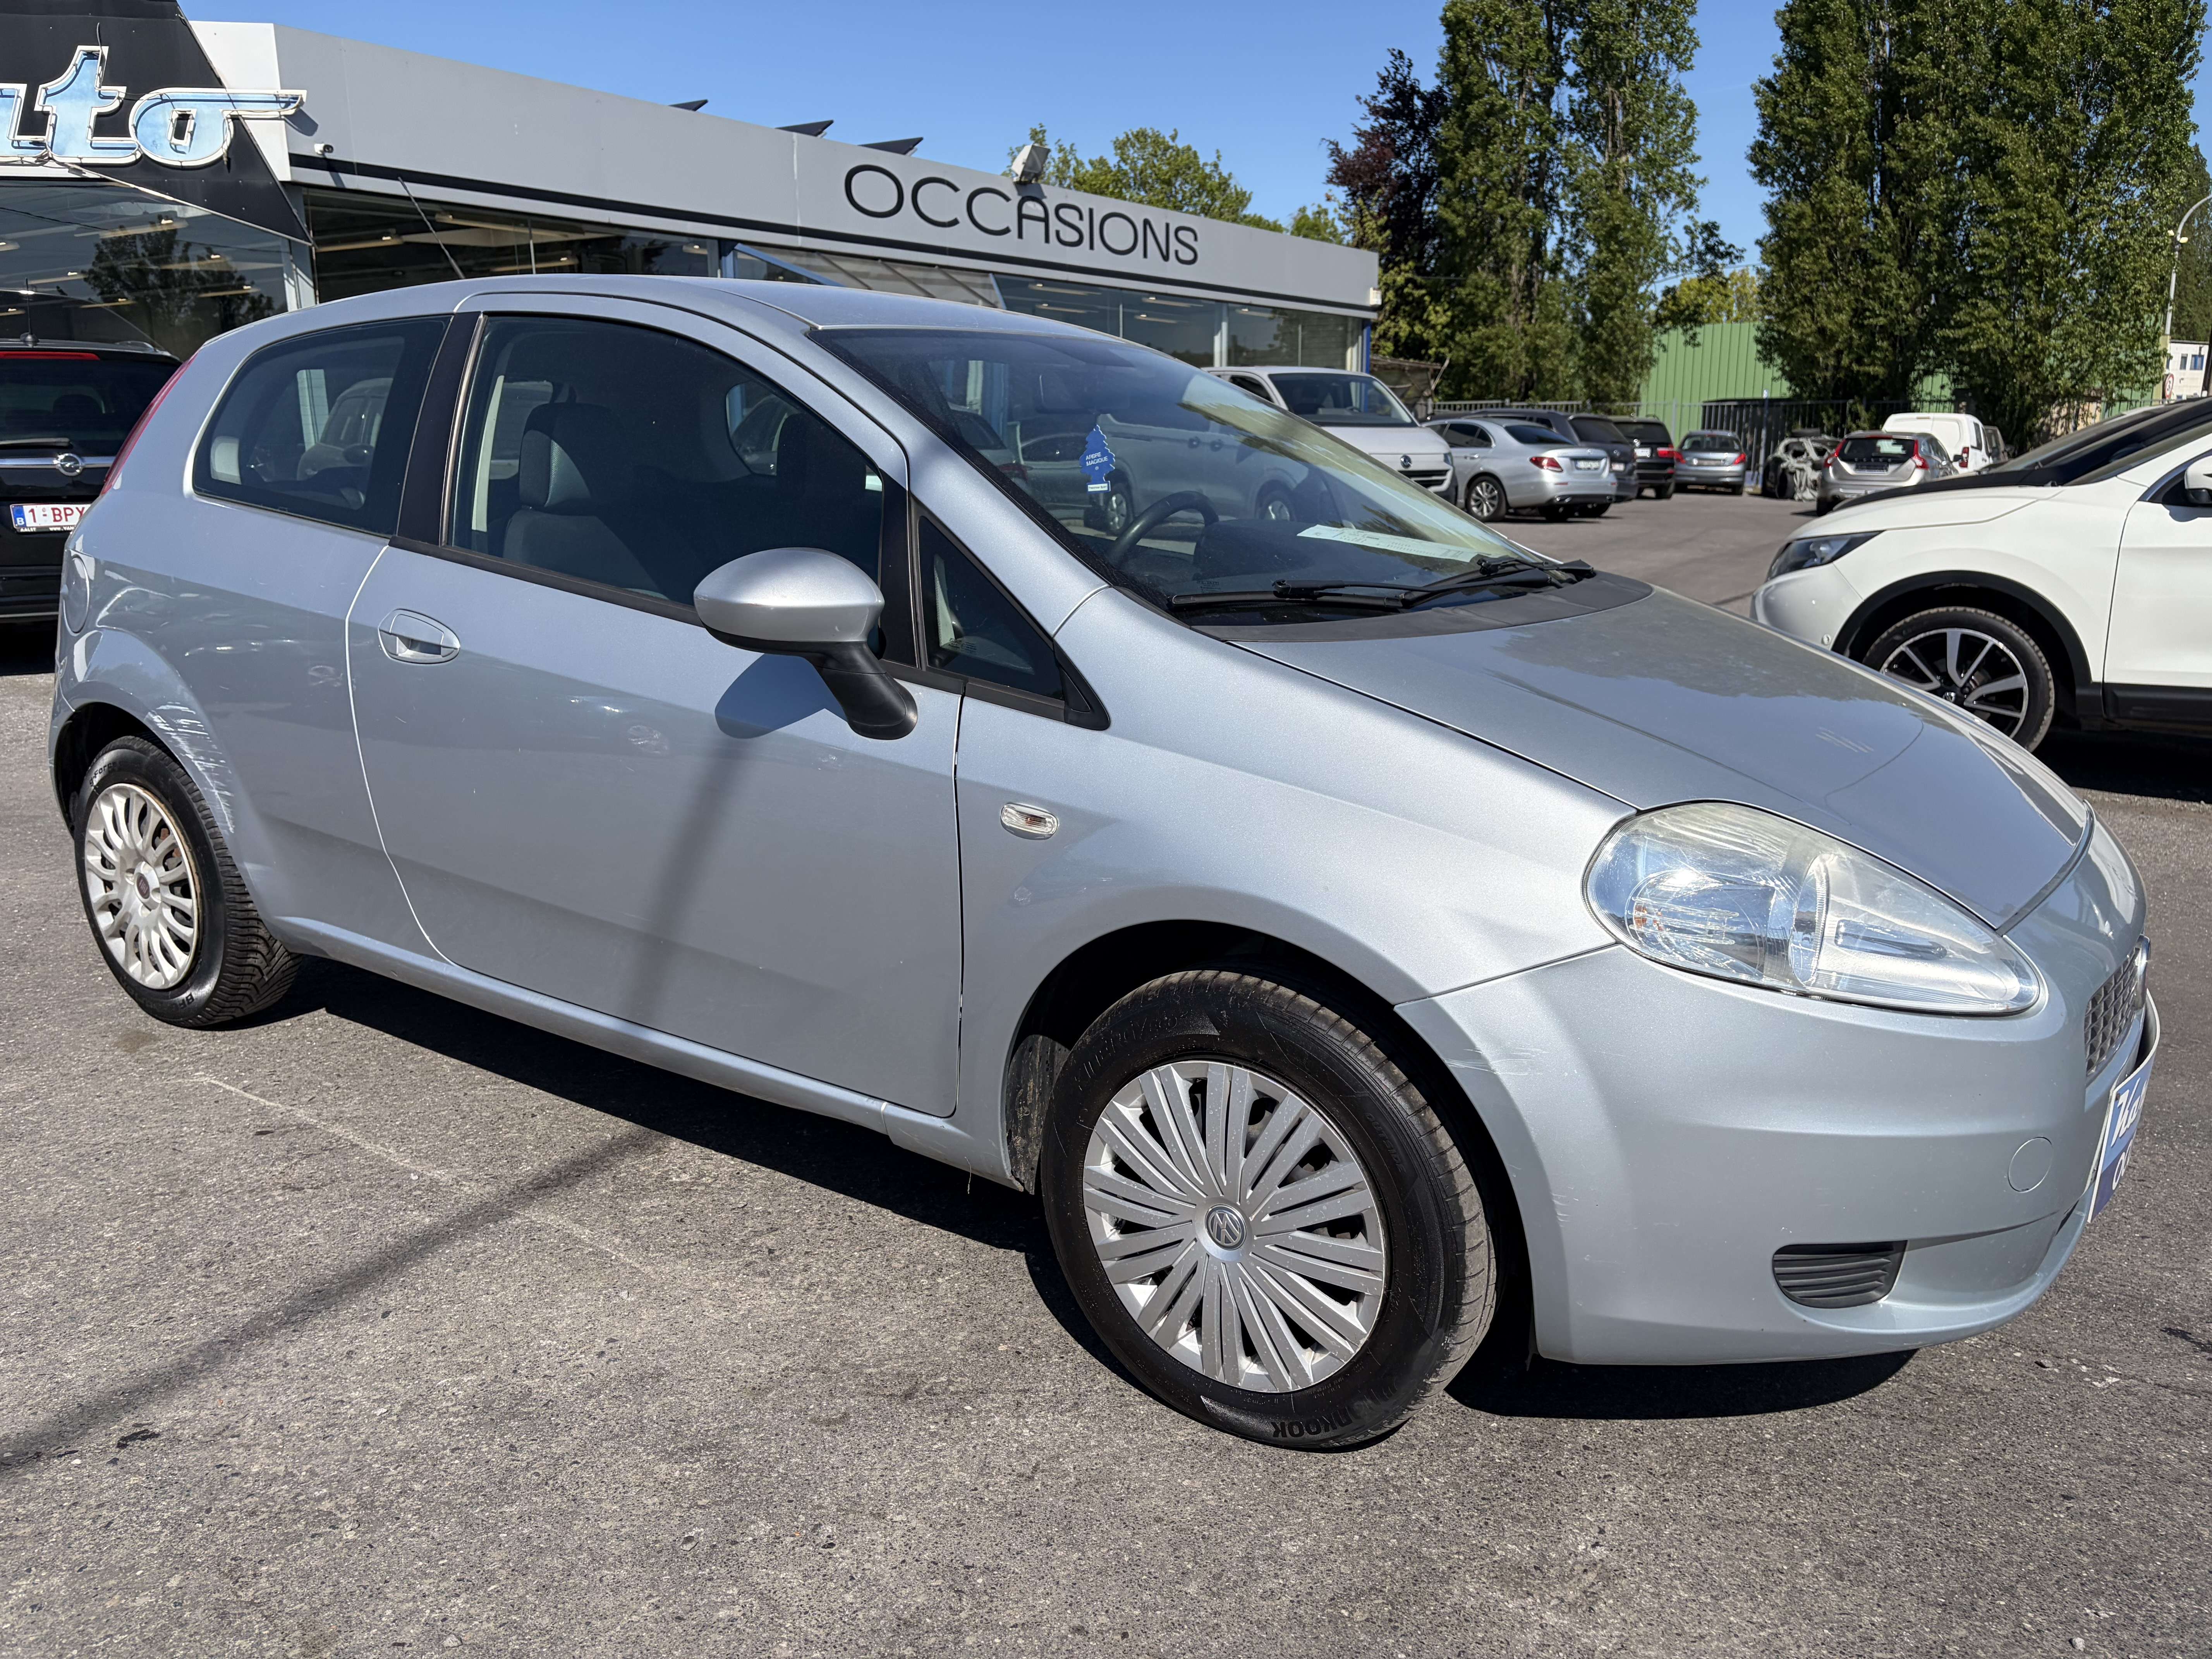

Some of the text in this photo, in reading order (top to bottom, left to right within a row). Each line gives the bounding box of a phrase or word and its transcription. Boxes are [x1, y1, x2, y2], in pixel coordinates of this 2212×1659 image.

[0, 45, 307, 167] to
[845, 164, 1198, 265] OCCASIONS
[1086, 452, 1101, 460] ARBRE
[1086, 456, 1108, 466] MAGIQUE
